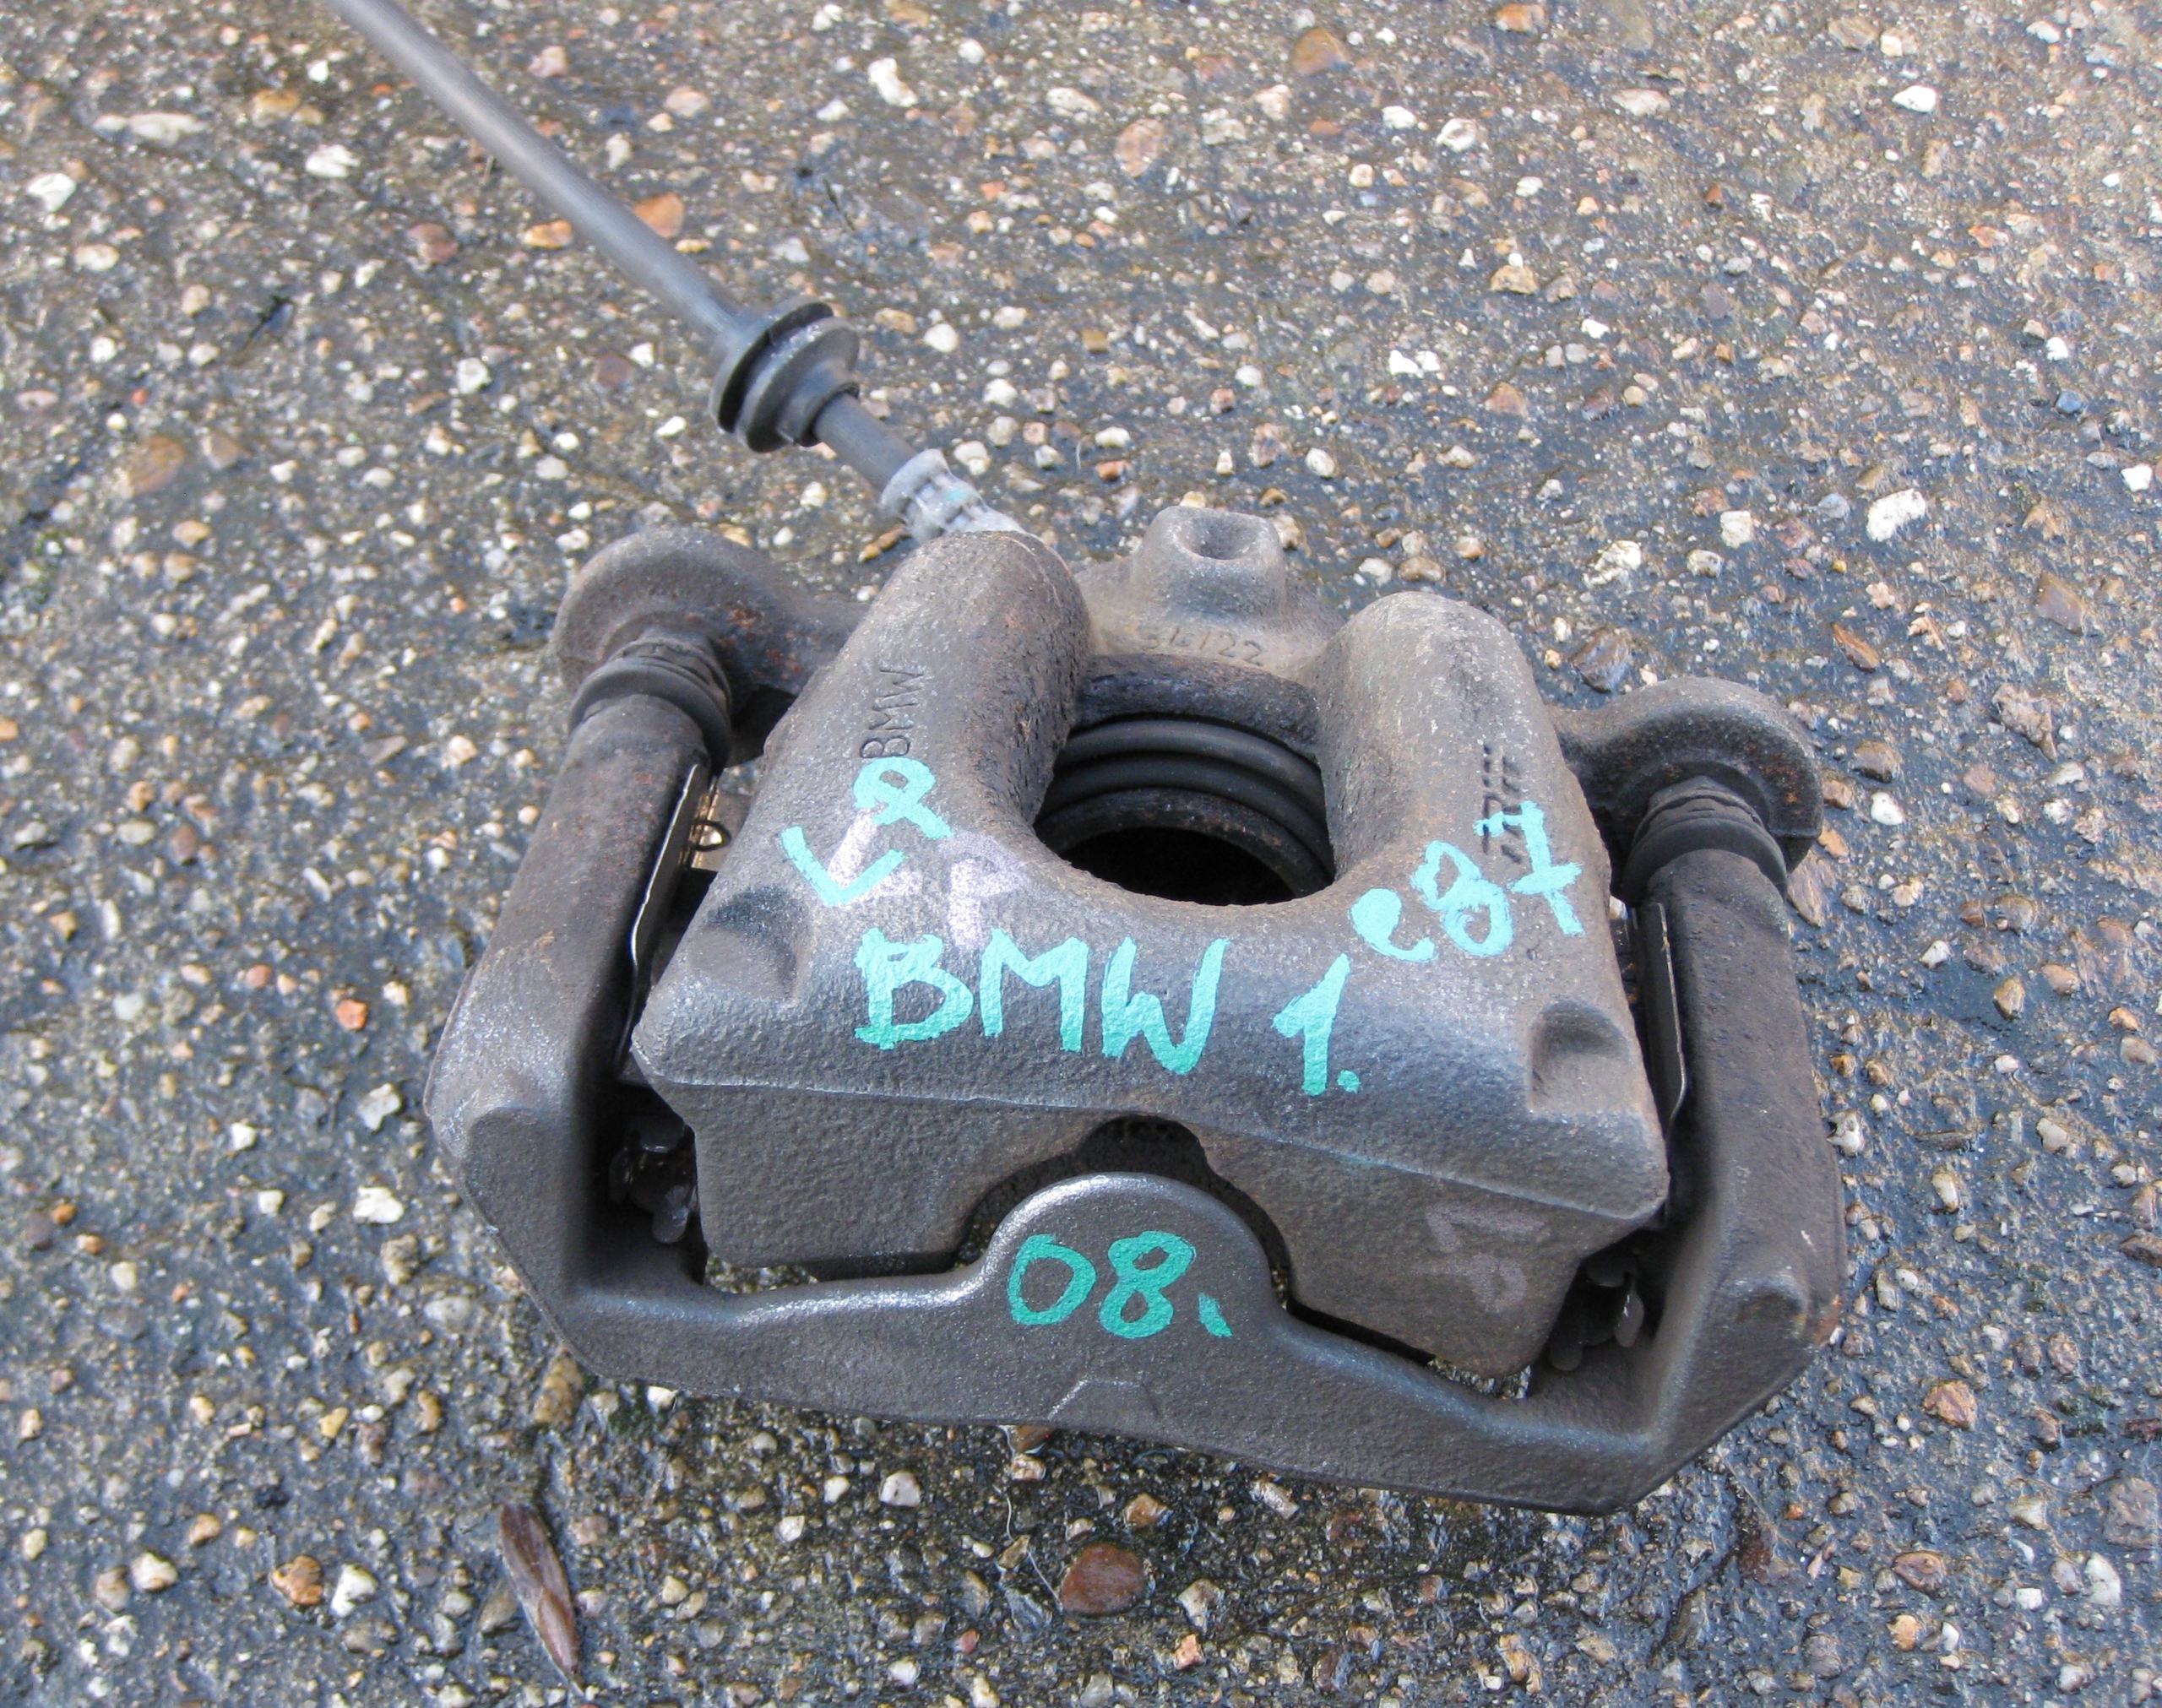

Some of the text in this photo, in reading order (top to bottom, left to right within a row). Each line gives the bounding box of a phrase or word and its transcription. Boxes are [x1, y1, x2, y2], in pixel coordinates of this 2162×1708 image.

[859, 666, 929, 758] BMW
[853, 927, 1362, 1096] BMW 1.
